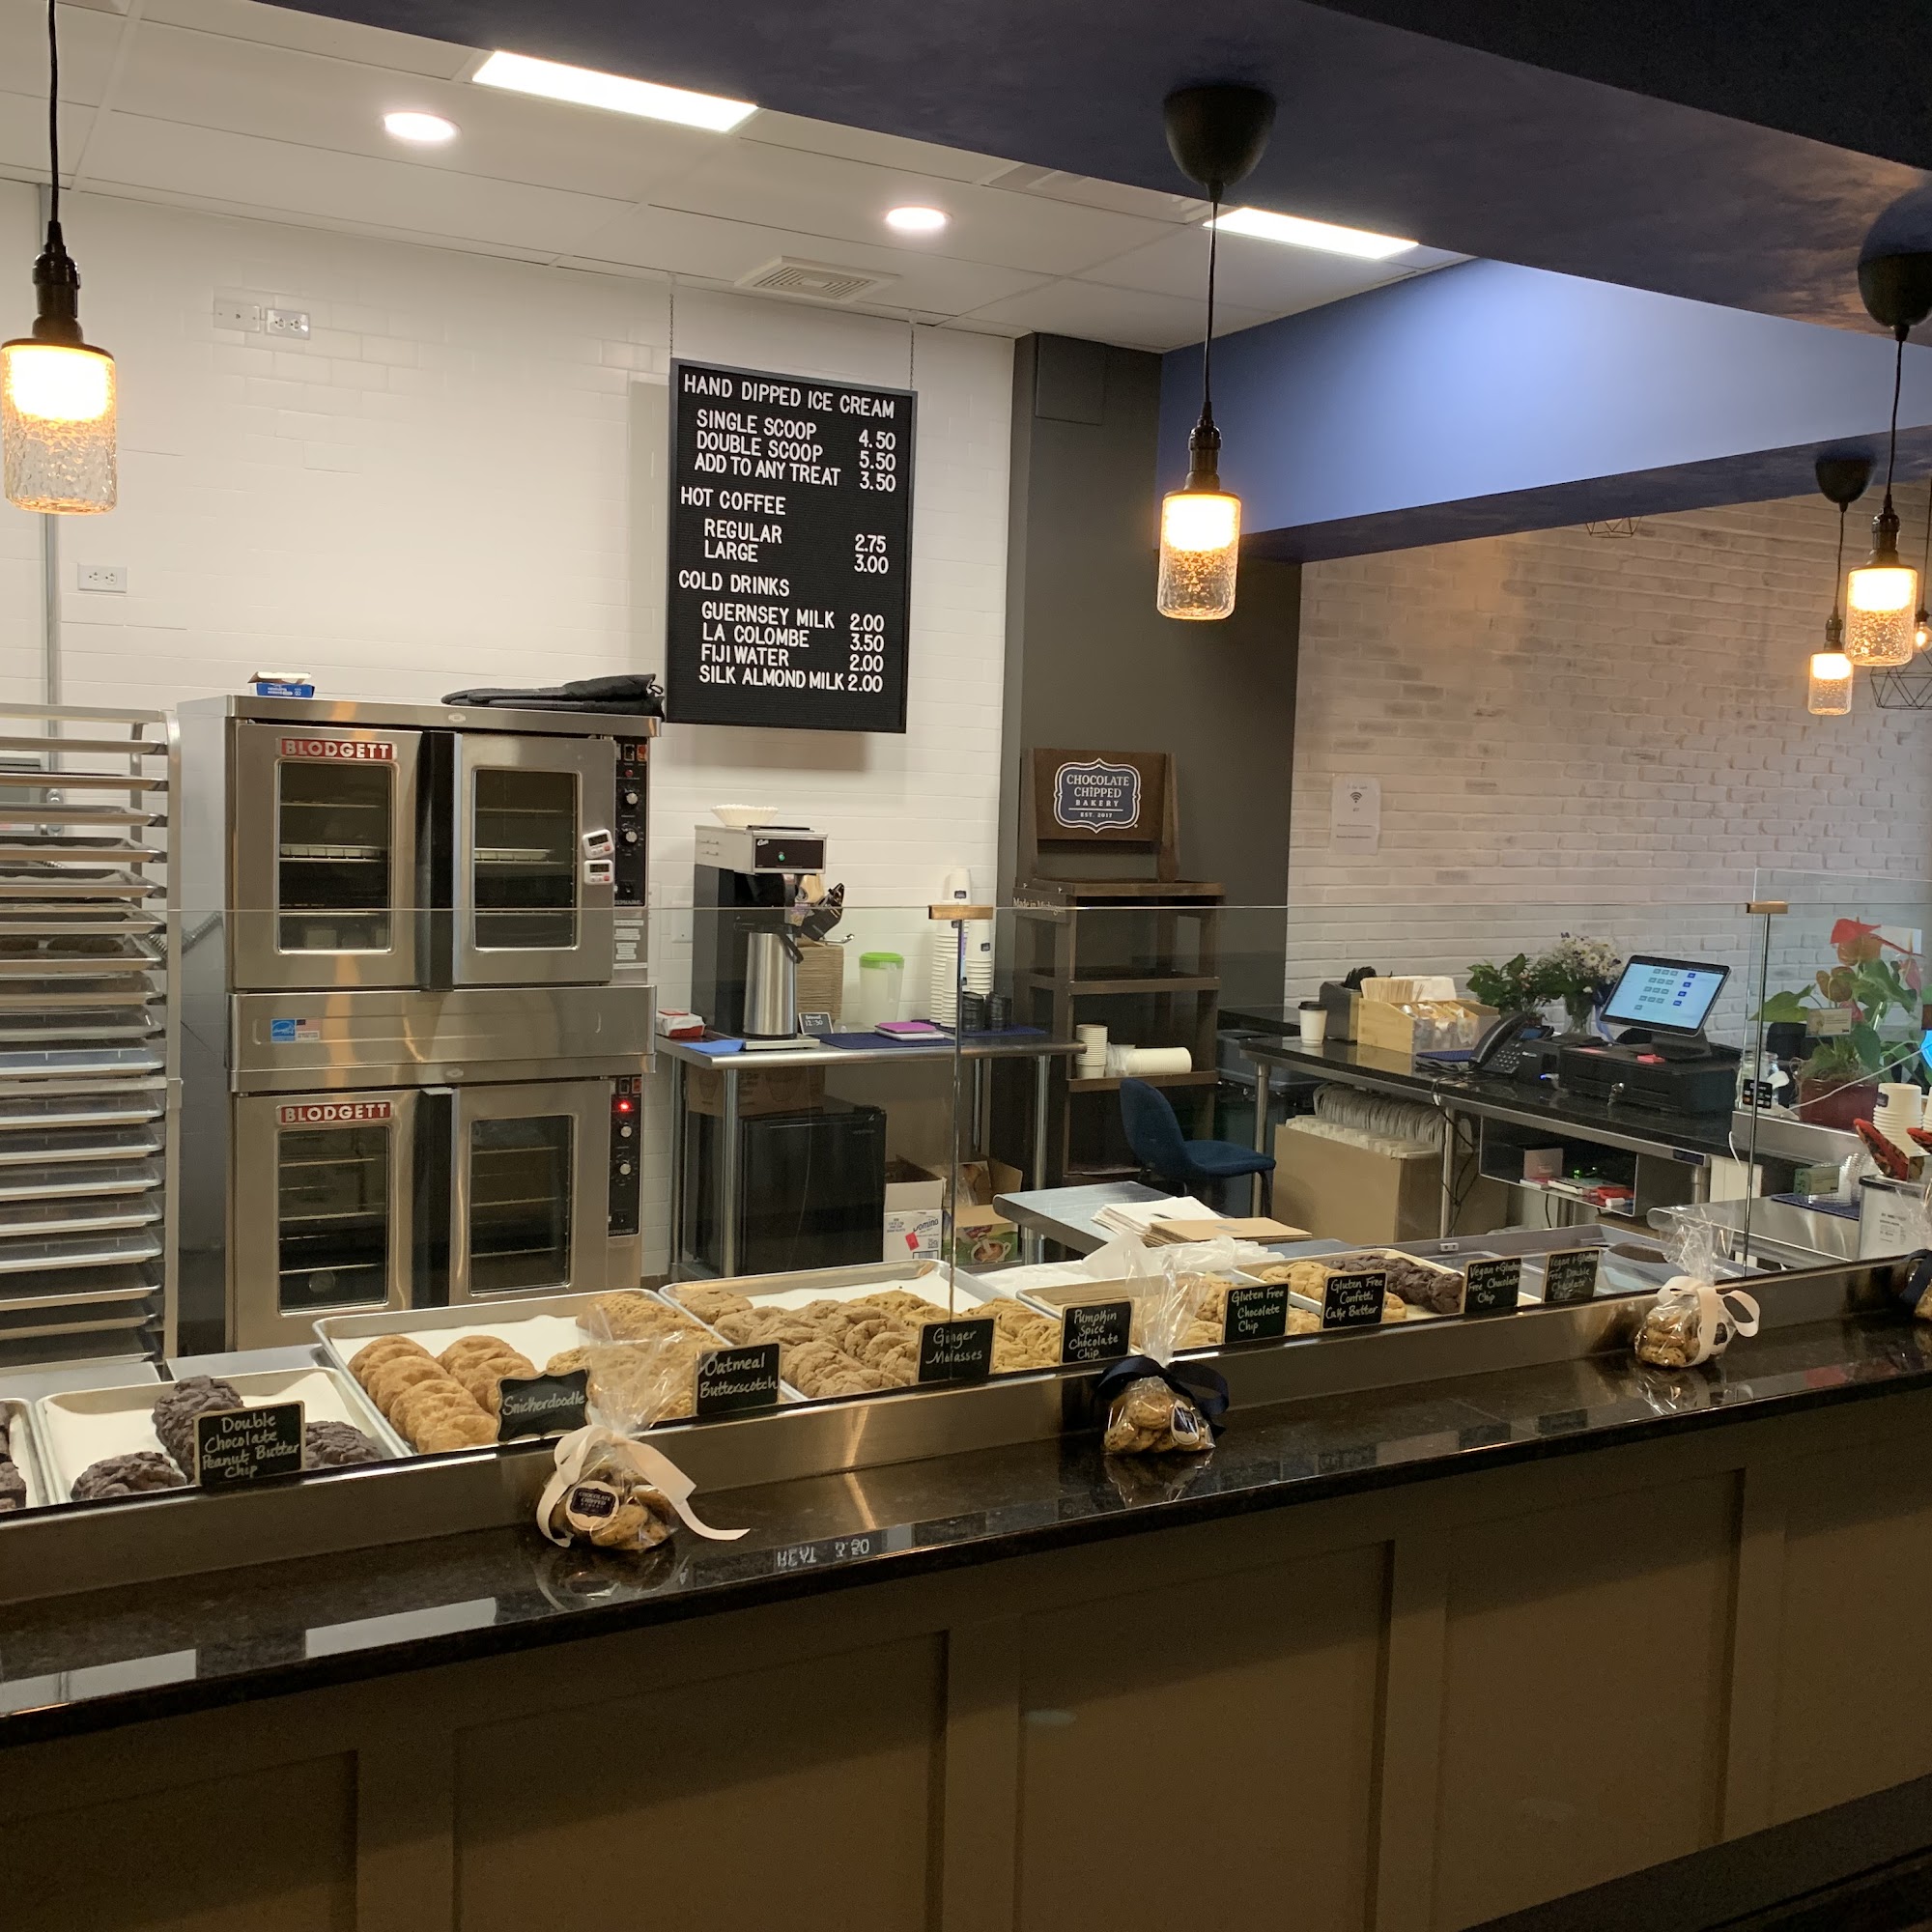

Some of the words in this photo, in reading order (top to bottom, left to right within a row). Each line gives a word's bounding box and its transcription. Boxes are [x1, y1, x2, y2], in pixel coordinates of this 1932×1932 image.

[684, 374, 732, 398] HAND
[741, 383, 801, 409] DIPPED
[808, 390, 833, 412] ICE
[839, 394, 895, 419] CREAM
[696, 410, 757, 435] SINGLE
[764, 418, 817, 440] SCOOP
[859, 429, 896, 451] 4.50
[696, 431, 761, 456] DOUBLE
[768, 440, 823, 463] SCOOP
[859, 450, 896, 471] 5.50
[695, 453, 726, 474] ADD
[731, 457, 752, 476] TO
[755, 460, 785, 481] ANY
[790, 464, 841, 487] TREAT
[860, 471, 896, 492] 3.50
[681, 487, 713, 507] HOT
[720, 491, 786, 516] COFFEE
[704, 519, 782, 544] REGULAR
[855, 534, 887, 554] 2.75
[704, 540, 758, 562] LARGE
[854, 554, 889, 575] 3.00
[679, 570, 723, 591] COLD
[730, 575, 790, 597] DRINKS
[701, 601, 790, 627] GUERNSEY
[797, 608, 835, 629] MILK
[850, 613, 885, 633] 2.00
[702, 623, 725, 642] LA
[734, 626, 810, 647] COLOMBE
[850, 634, 885, 653] 3.50
[701, 643, 730, 664] FIJI
[735, 646, 789, 667] WATER
[849, 655, 884, 673] 2.00
[698, 665, 736, 684] SILK
[742, 669, 807, 688] ALMOND
[810, 671, 844, 691] MILK
[848, 673, 883, 693] 2.00
[285, 740, 389, 759] BLODGETT
[1066, 774, 1129, 786] CHOCOLATE
[284, 1103, 387, 1122] BLODGETT
[1469, 1264, 1494, 1281] Vegan
[1330, 1279, 1362, 1293] Gluten
[1365, 1276, 1383, 1288] Free
[1231, 1290, 1264, 1306] Gluten
[1266, 1287, 1285, 1299] Free
[1339, 1290, 1375, 1304] Confetti
[1478, 1291, 1496, 1305] Chip
[1236, 1304, 1281, 1320] Chocolate
[932, 1327, 977, 1350] Ginger
[1078, 1324, 1105, 1340] Spice
[1237, 1320, 1259, 1334] Chip
[1068, 1333, 1119, 1350] Chocolate
[704, 1351, 766, 1377] Oatmeal
[924, 1350, 982, 1364] Molasses
[1076, 1348, 1099, 1360] Chip
[699, 1376, 779, 1399] Butterscotch
[221, 1412, 276, 1434] Double
[204, 1430, 278, 1454] Chocolate
[202, 1450, 250, 1470] Peanut
[254, 1440, 300, 1460] Butter
[224, 1463, 258, 1478] Chip
